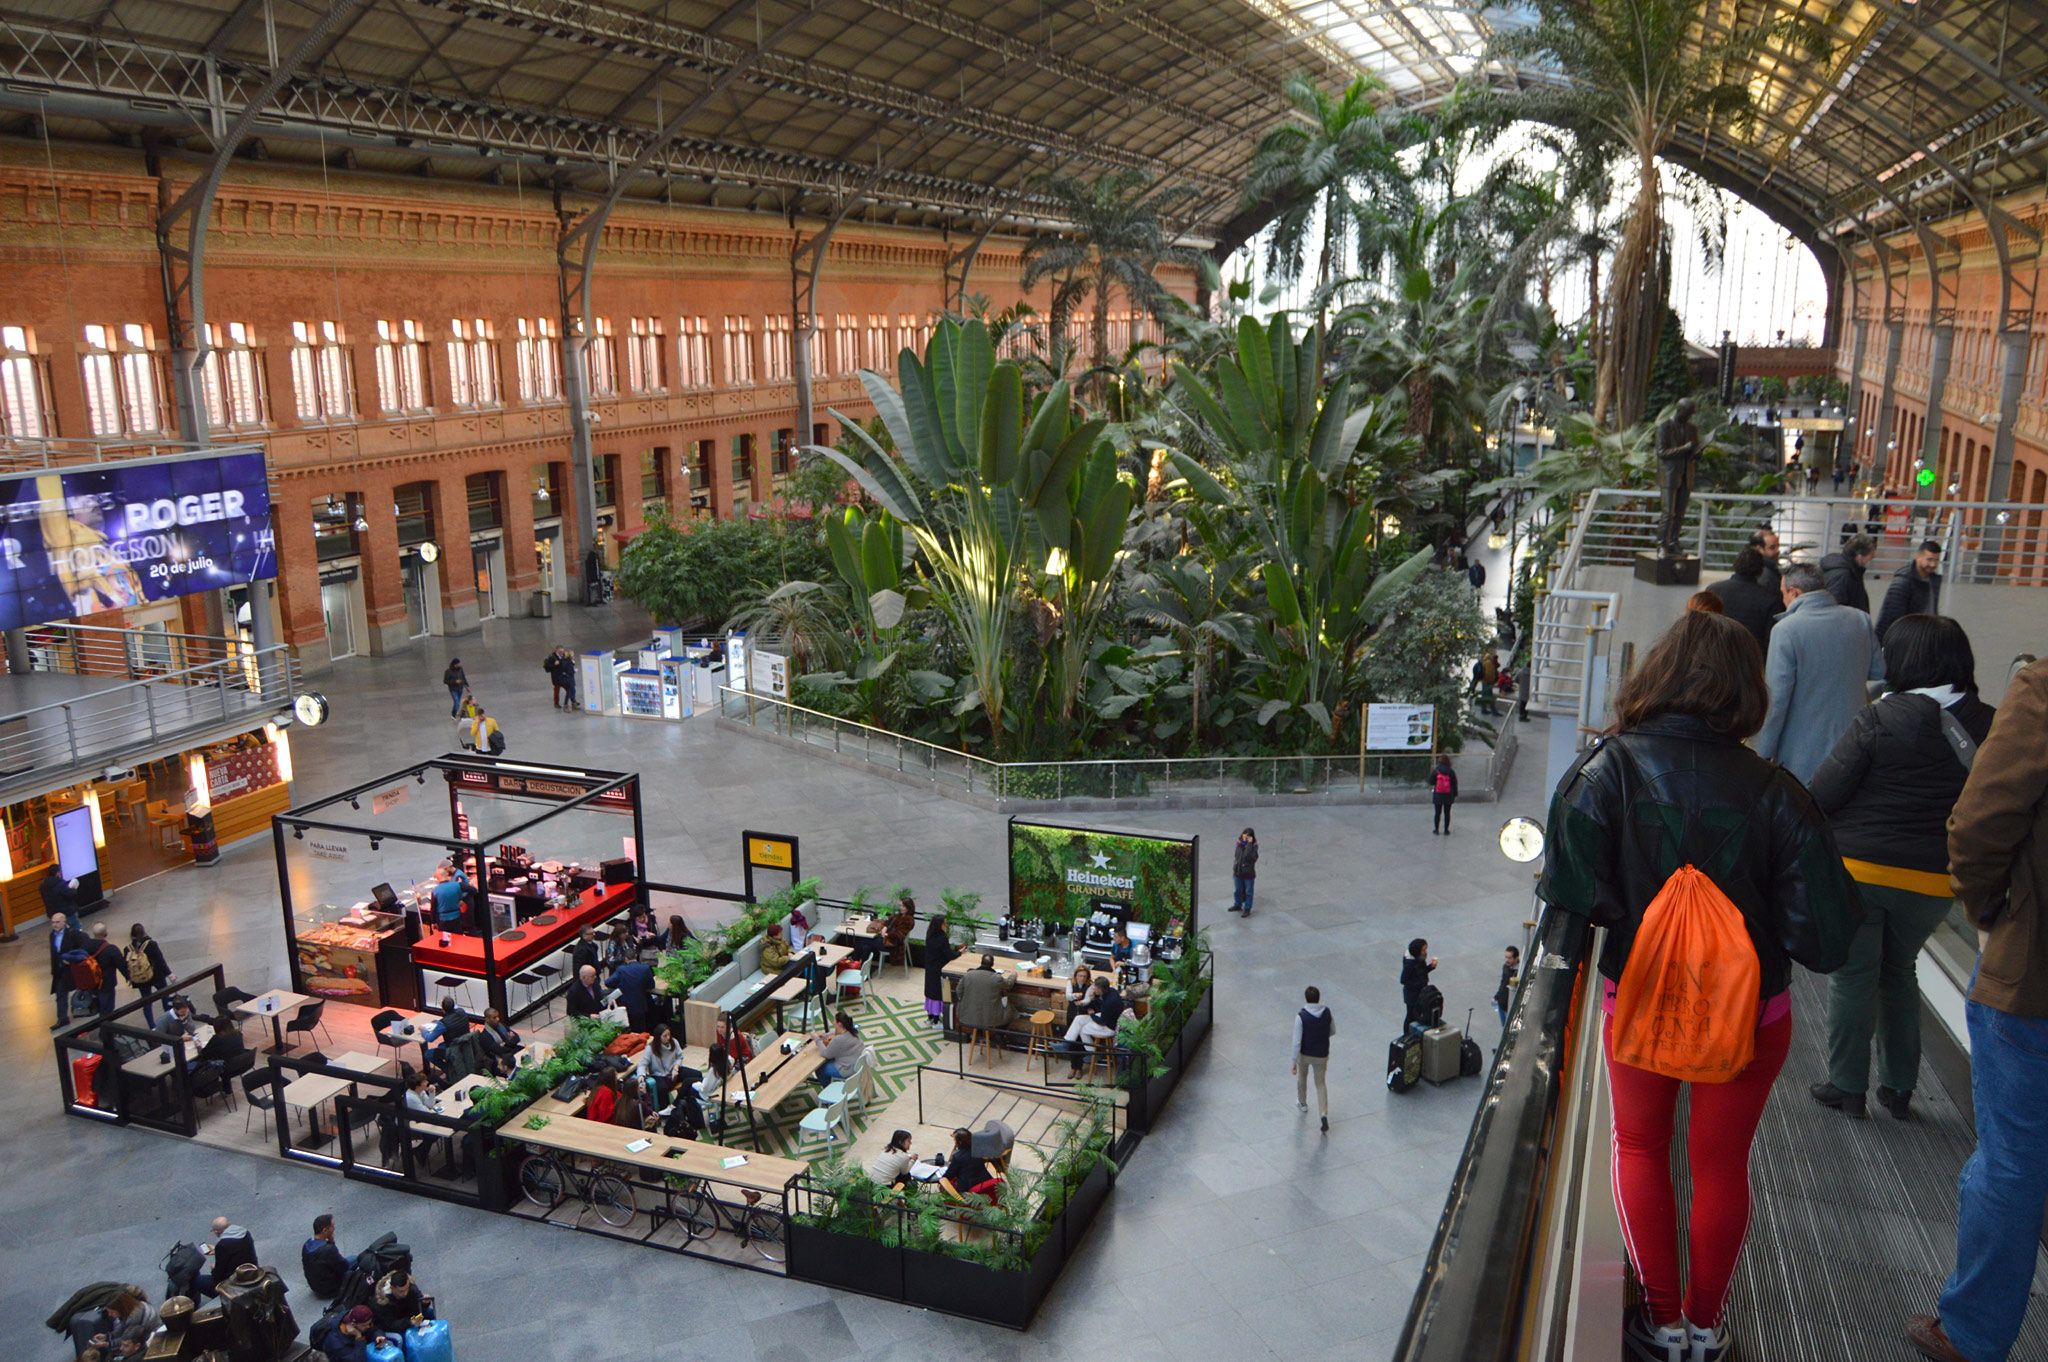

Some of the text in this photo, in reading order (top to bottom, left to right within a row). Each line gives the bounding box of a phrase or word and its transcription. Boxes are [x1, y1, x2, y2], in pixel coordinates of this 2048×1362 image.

[125, 490, 246, 532] ROGER
[150, 556, 214, 578] 20 de julio
[310, 841, 347, 853] PARA LLEVAR
[1067, 868, 1135, 889] Heineken
[1067, 884, 1105, 897] GRAND
[1693, 1333, 1707, 1342] NIKE
